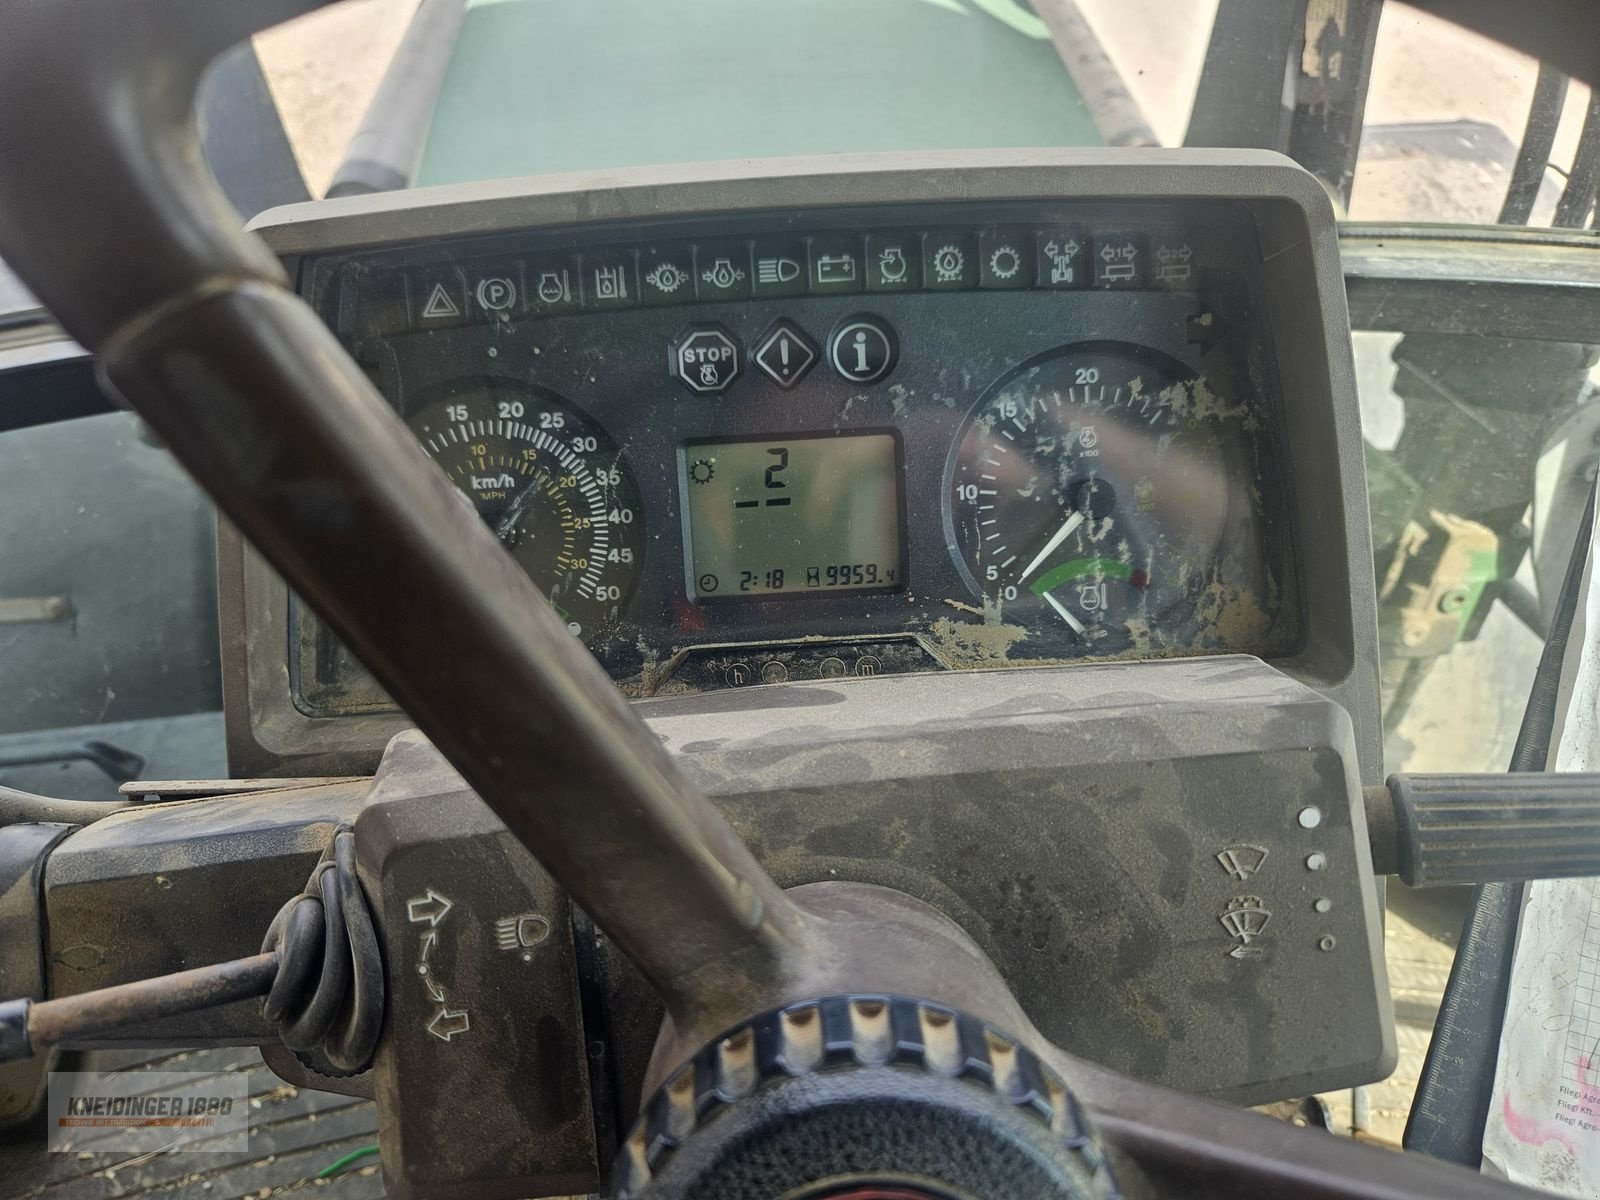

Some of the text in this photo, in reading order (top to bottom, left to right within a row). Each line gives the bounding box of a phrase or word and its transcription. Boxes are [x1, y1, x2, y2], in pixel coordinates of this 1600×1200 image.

[490, 285, 504, 302] P
[684, 347, 731, 363] STOP
[1075, 368, 1098, 384] 20
[447, 405, 468, 421] 15
[499, 402, 524, 418] 20
[997, 400, 1017, 418] 15
[540, 412, 565, 429] 25
[471, 445, 486, 456] 10
[573, 436, 597, 452] 30
[522, 449, 537, 461] 15
[1079, 449, 1099, 458] x100
[765, 448, 788, 488] 2
[471, 473, 515, 489] km/h
[560, 476, 576, 488] 20
[596, 467, 620, 486] 35
[481, 491, 506, 501] MPH
[956, 485, 977, 500] 10
[574, 518, 591, 529] 25
[609, 509, 633, 524] 40
[570, 558, 587, 569] 30
[608, 549, 633, 564] 45
[740, 569, 784, 591] 2:18
[986, 565, 998, 581] 5
[596, 586, 620, 601] 50
[1005, 586, 1017, 600] 0
[734, 668, 743, 684] h
[1560, 1085, 1581, 1099] Fliegl
[1557, 1099, 1579, 1112] Fliegl
[1555, 1112, 1576, 1126] Fliegl
